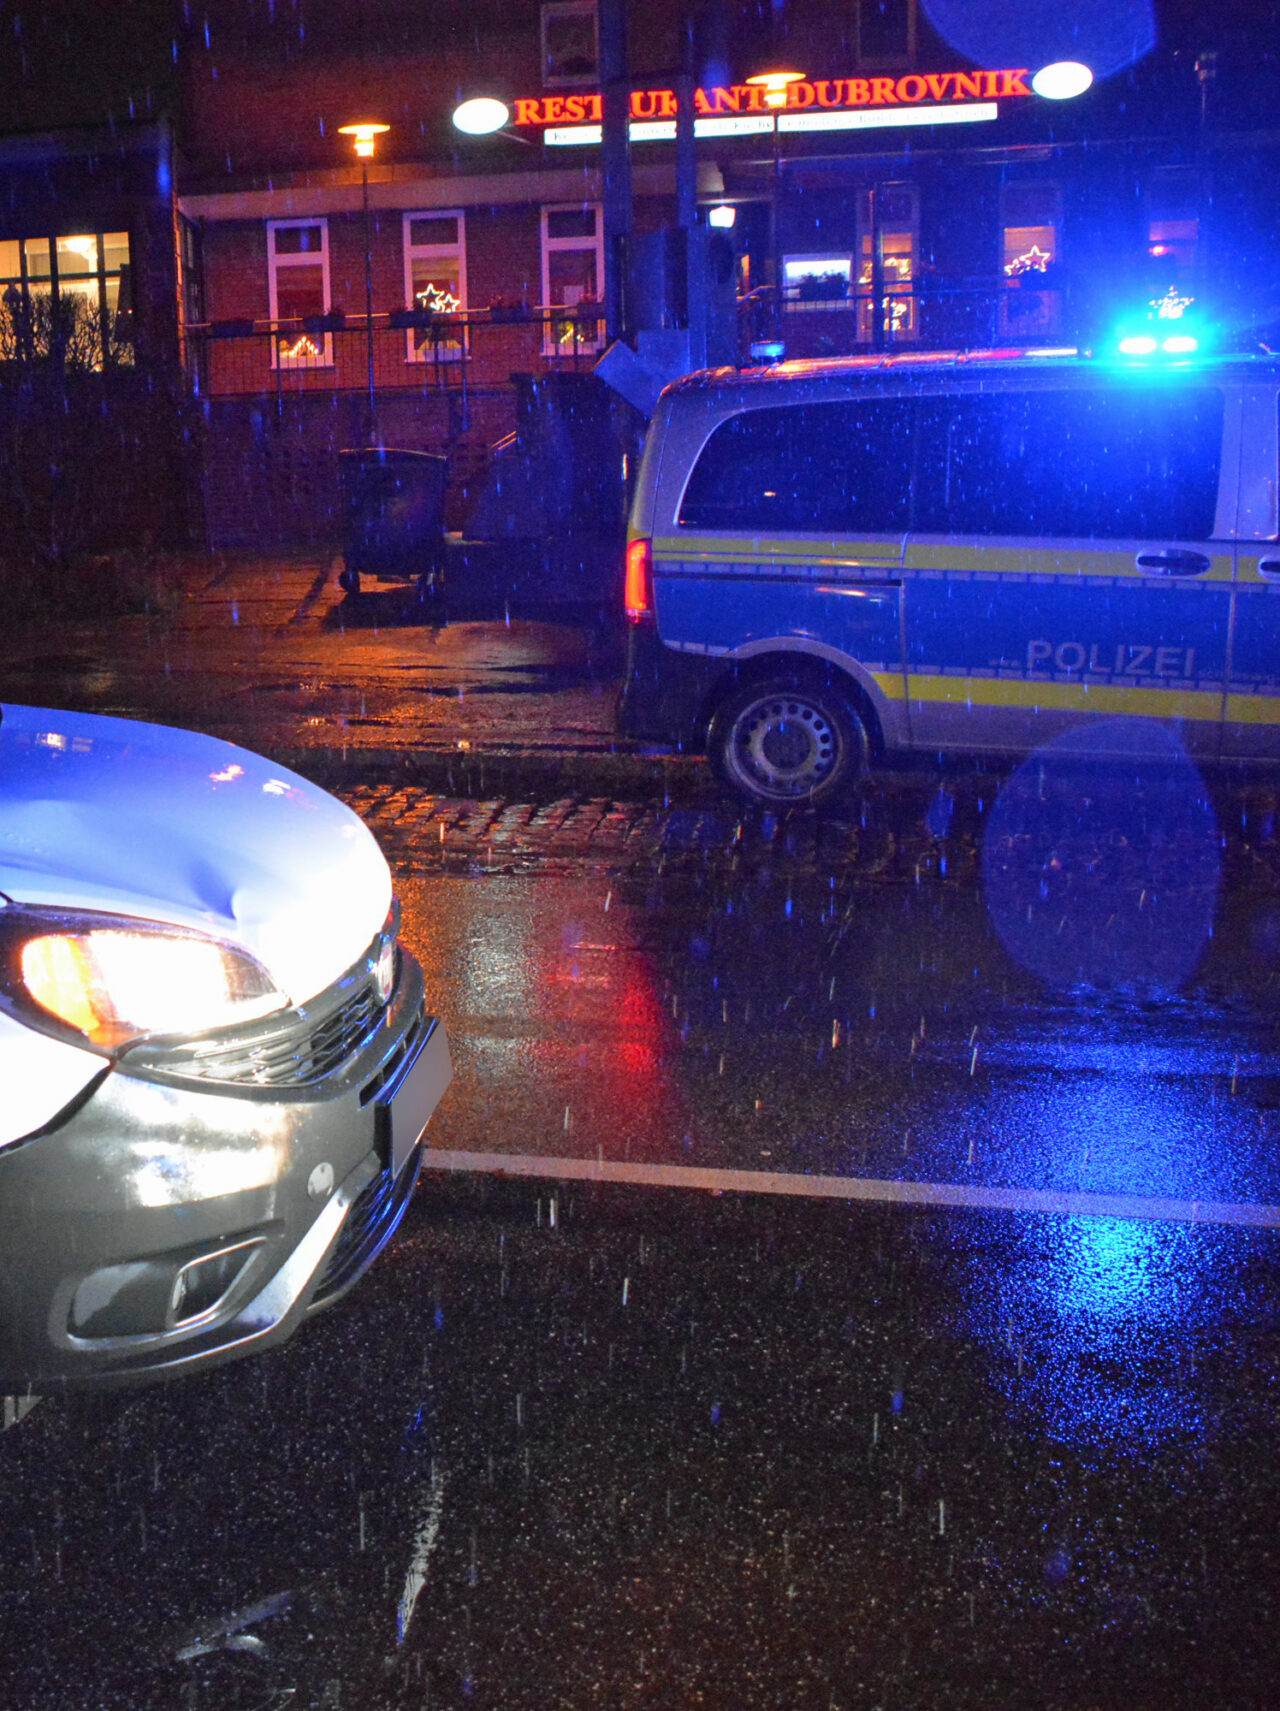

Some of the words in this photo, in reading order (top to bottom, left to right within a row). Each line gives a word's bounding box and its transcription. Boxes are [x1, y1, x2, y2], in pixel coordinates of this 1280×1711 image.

[514, 84, 769, 125] RESTURANT
[786, 69, 1031, 109] DUBROVNIK
[1026, 640, 1195, 677] POLIZEI
